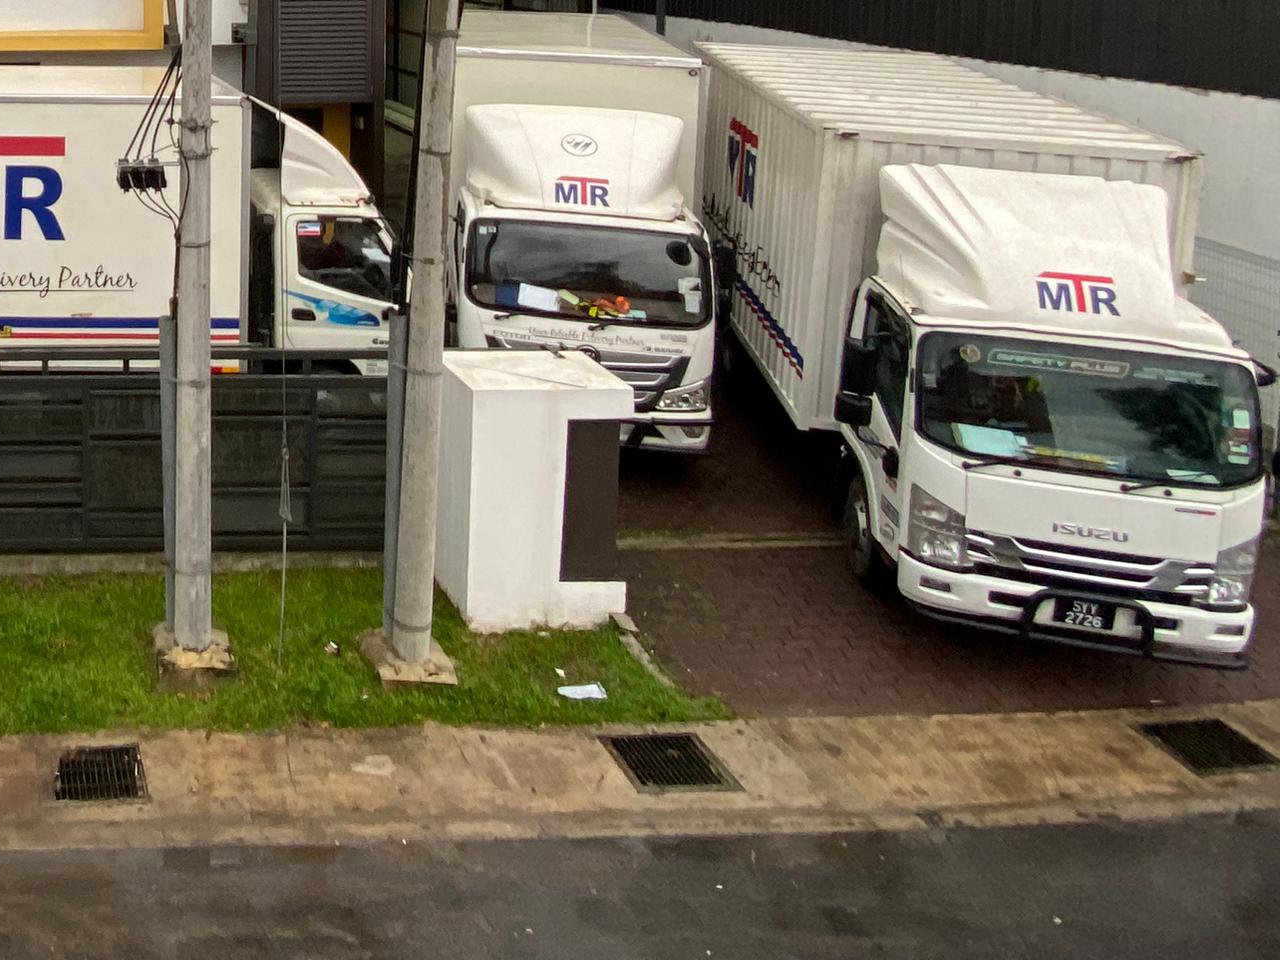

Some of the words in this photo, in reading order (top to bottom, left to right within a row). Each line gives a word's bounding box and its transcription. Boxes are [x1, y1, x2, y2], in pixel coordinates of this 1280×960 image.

[554, 175, 610, 208] MTR
[57, 264, 138, 289] Partner
[1035, 271, 1121, 318] MTR
[1051, 520, 1129, 543] ISUZU
[1064, 610, 1103, 629] 2726
